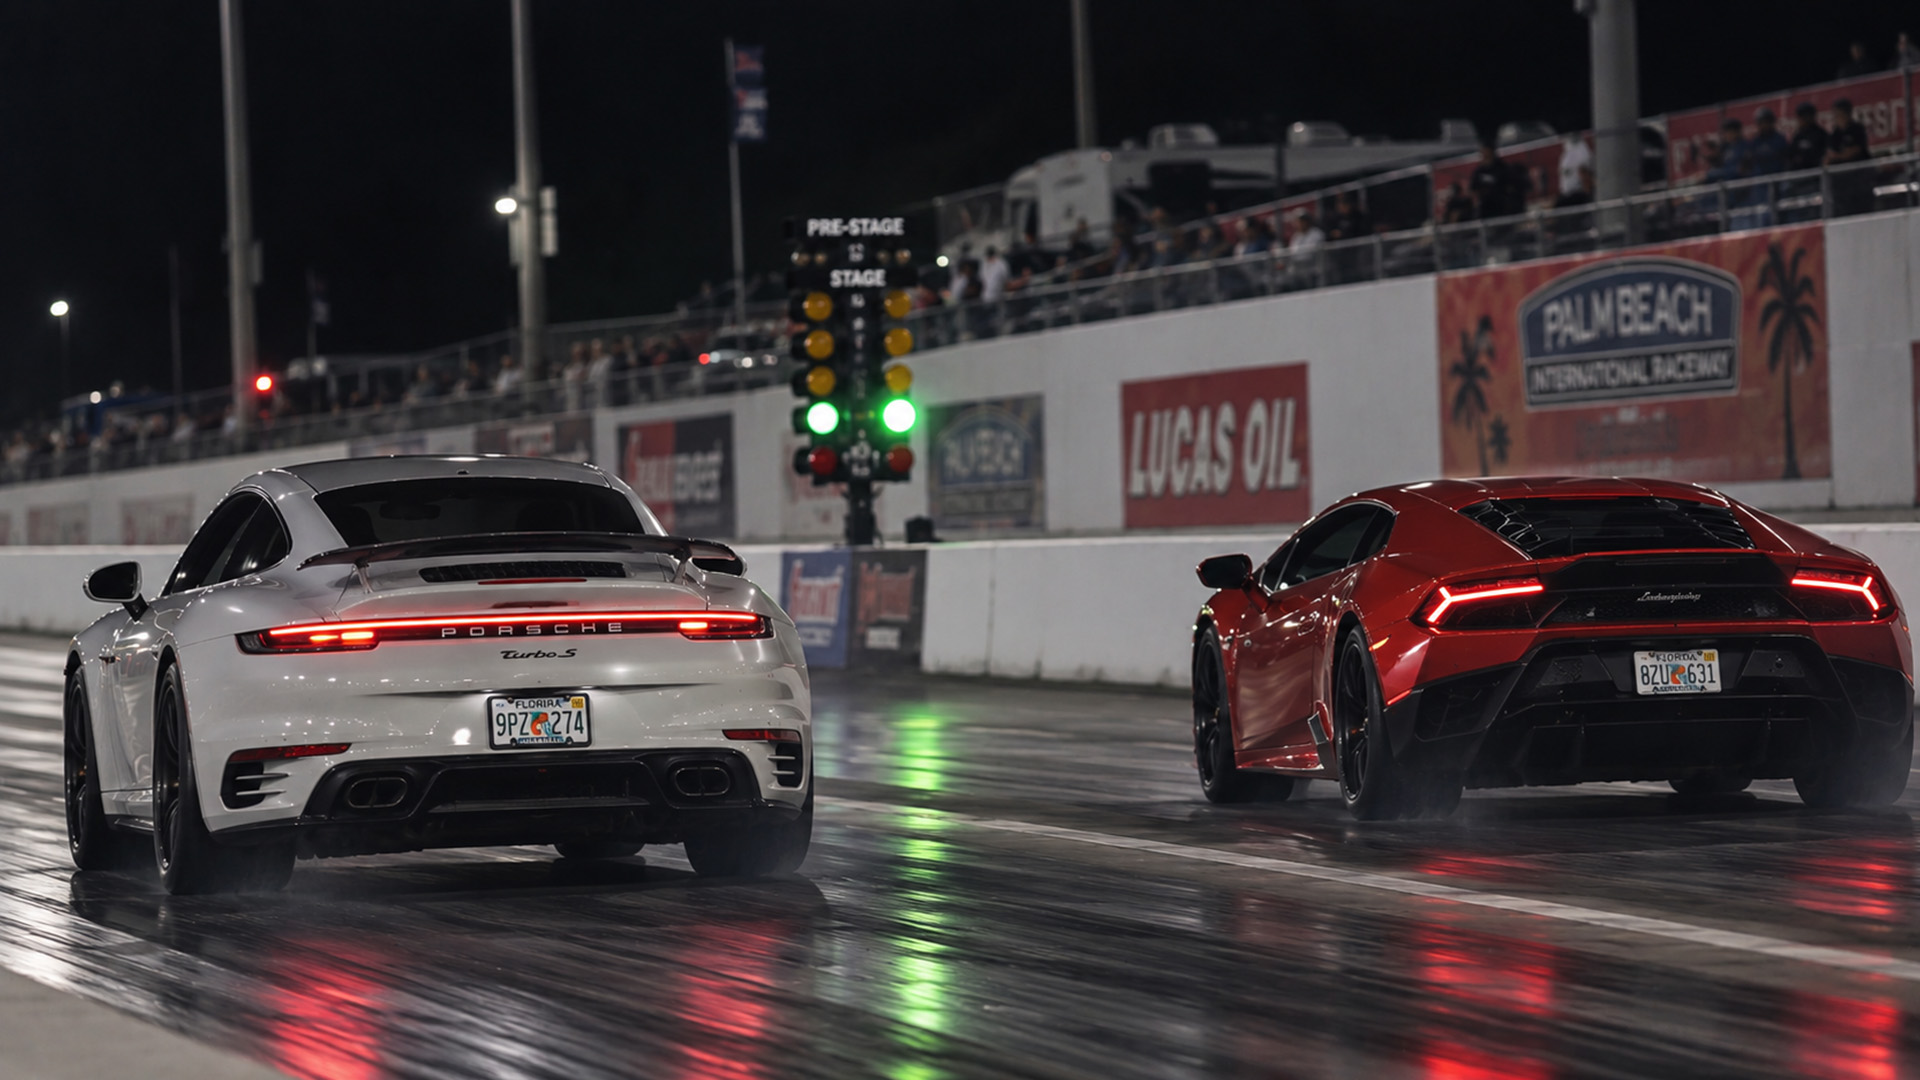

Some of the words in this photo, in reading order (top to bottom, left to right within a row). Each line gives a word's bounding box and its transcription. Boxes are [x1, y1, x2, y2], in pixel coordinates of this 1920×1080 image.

[807, 217, 905, 237] PRE-STAGE
[829, 268, 886, 288] STAGE
[1543, 287, 1614, 352] PALM
[1616, 281, 1713, 337] BEACH
[1533, 358, 1649, 393] INTERNATIONAL
[1651, 351, 1731, 383] RACEWAY
[1128, 401, 1236, 499] LUCAS
[1243, 397, 1301, 494] OIL
[441, 622, 622, 638] PORSCHE
[500, 649, 557, 660] Turbo
[557, 648, 577, 658] S
[1640, 663, 1669, 685] 8ZU
[1687, 662, 1716, 684] 631
[496, 711, 530, 737] 9PZ
[551, 710, 584, 735] 274
